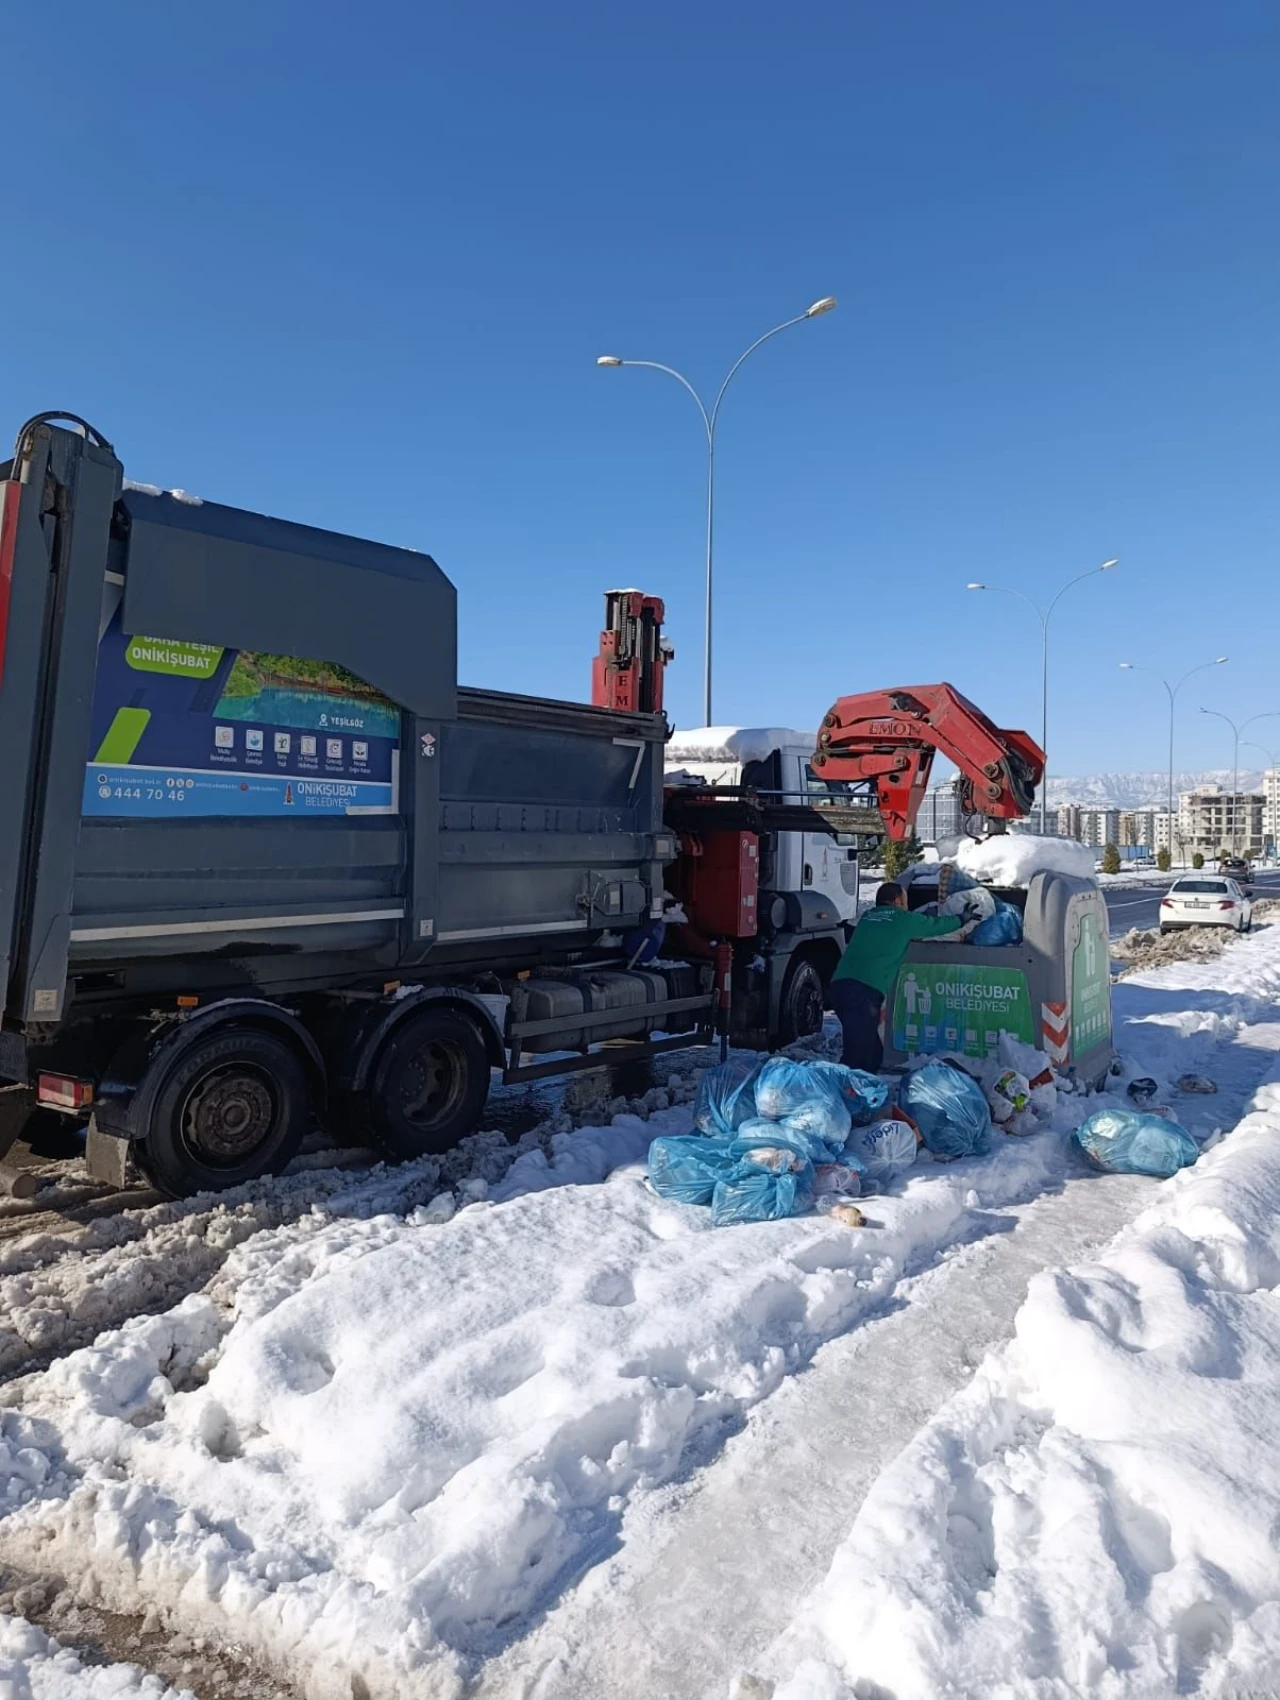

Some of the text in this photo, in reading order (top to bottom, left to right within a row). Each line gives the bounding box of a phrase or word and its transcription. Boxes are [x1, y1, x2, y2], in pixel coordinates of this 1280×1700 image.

[132, 647, 212, 669] ONİKİŞUBAT
[114, 787, 185, 801] 444 70 46
[935, 982, 1020, 1000] ONİKİŞUBAT
[946, 998, 1010, 1013] BELEDİYESİ
